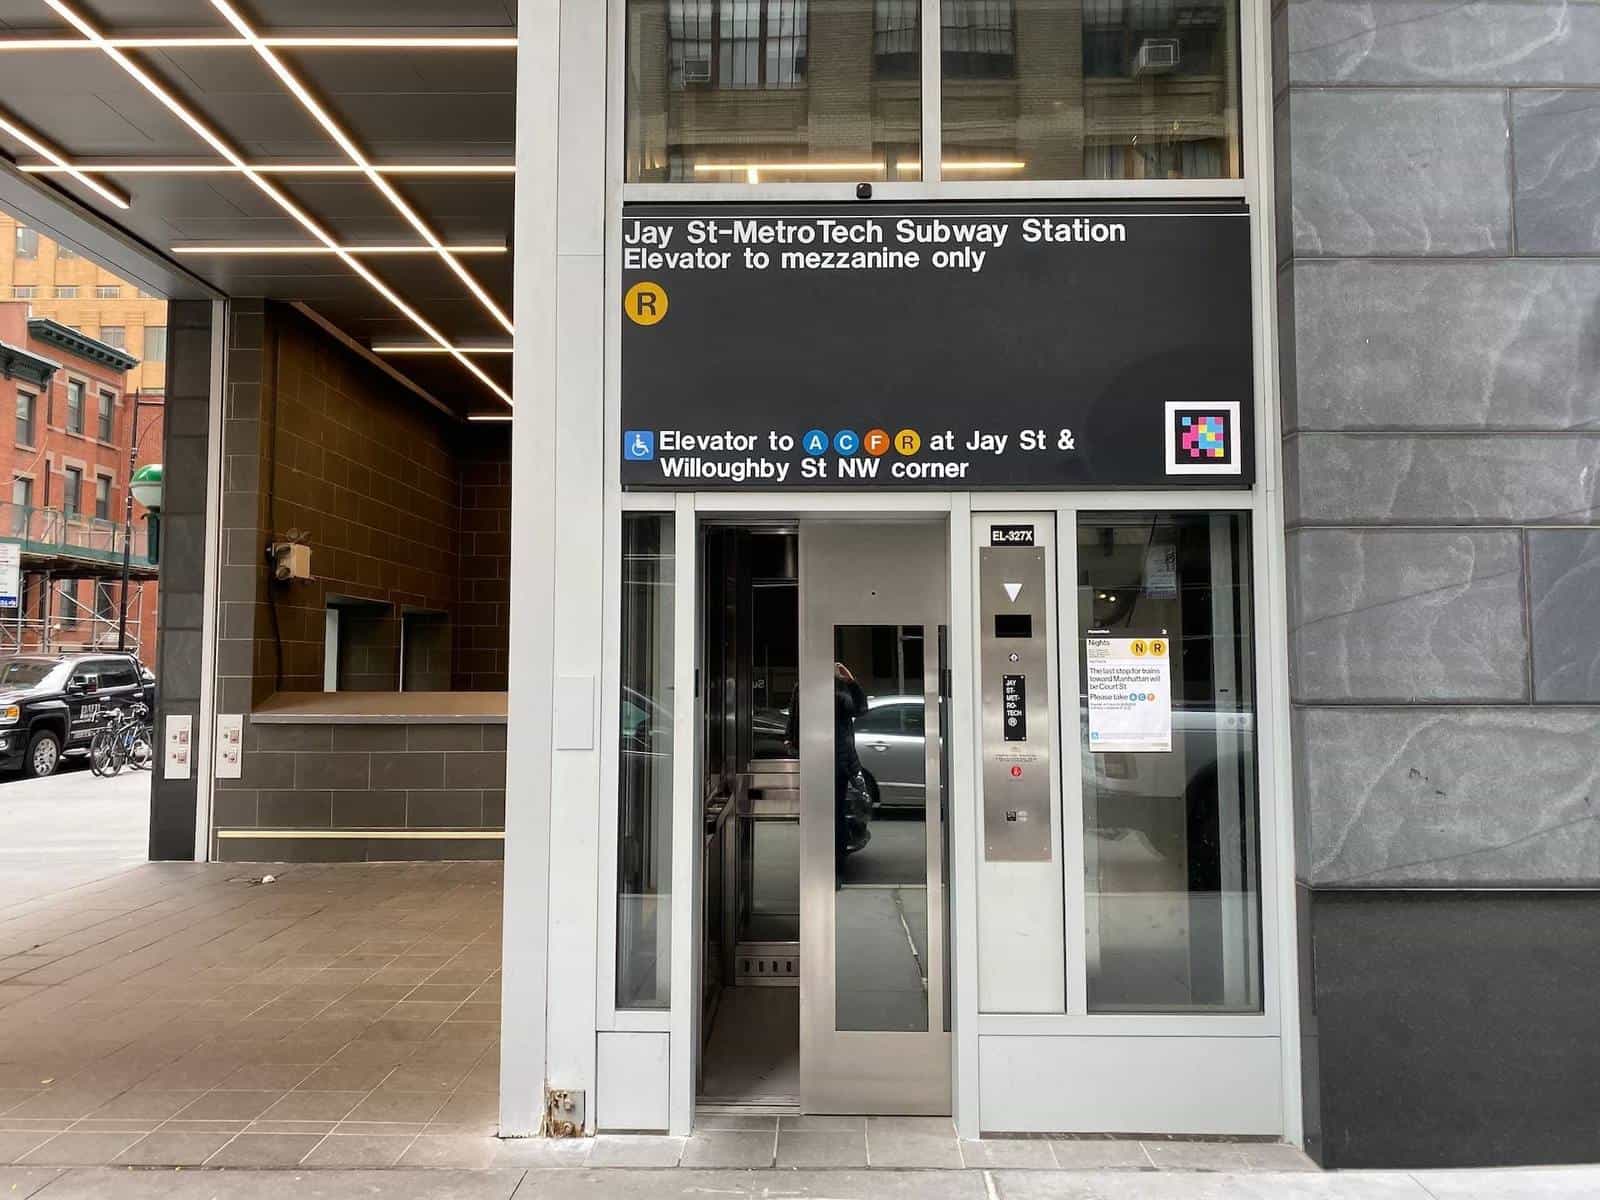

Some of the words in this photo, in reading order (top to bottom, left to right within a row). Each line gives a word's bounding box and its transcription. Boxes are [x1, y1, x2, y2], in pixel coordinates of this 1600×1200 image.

[624, 220, 673, 248] Jay
[896, 219, 1008, 247] Subway
[1022, 218, 1126, 242] Station
[624, 247, 731, 269] Elevator
[743, 247, 770, 269] to
[781, 247, 920, 269] mezzanine
[931, 246, 986, 272] only
[636, 292, 657, 316] R
[659, 430, 757, 451] Elevator
[768, 430, 794, 451] to
[808, 434, 823, 450] A
[838, 434, 853, 450] C
[870, 434, 883, 450] F
[901, 434, 914, 450] R
[929, 430, 954, 451] at
[966, 430, 1009, 455] Jay
[1019, 429, 1047, 451] St
[1057, 429, 1075, 450] &
[660, 457, 790, 482] Willoughby
[801, 457, 827, 478] St
[838, 457, 880, 478] NW
[891, 460, 969, 478] corner
[992, 530, 1033, 542] EL-327X
[1088, 639, 1110, 648] Nights
